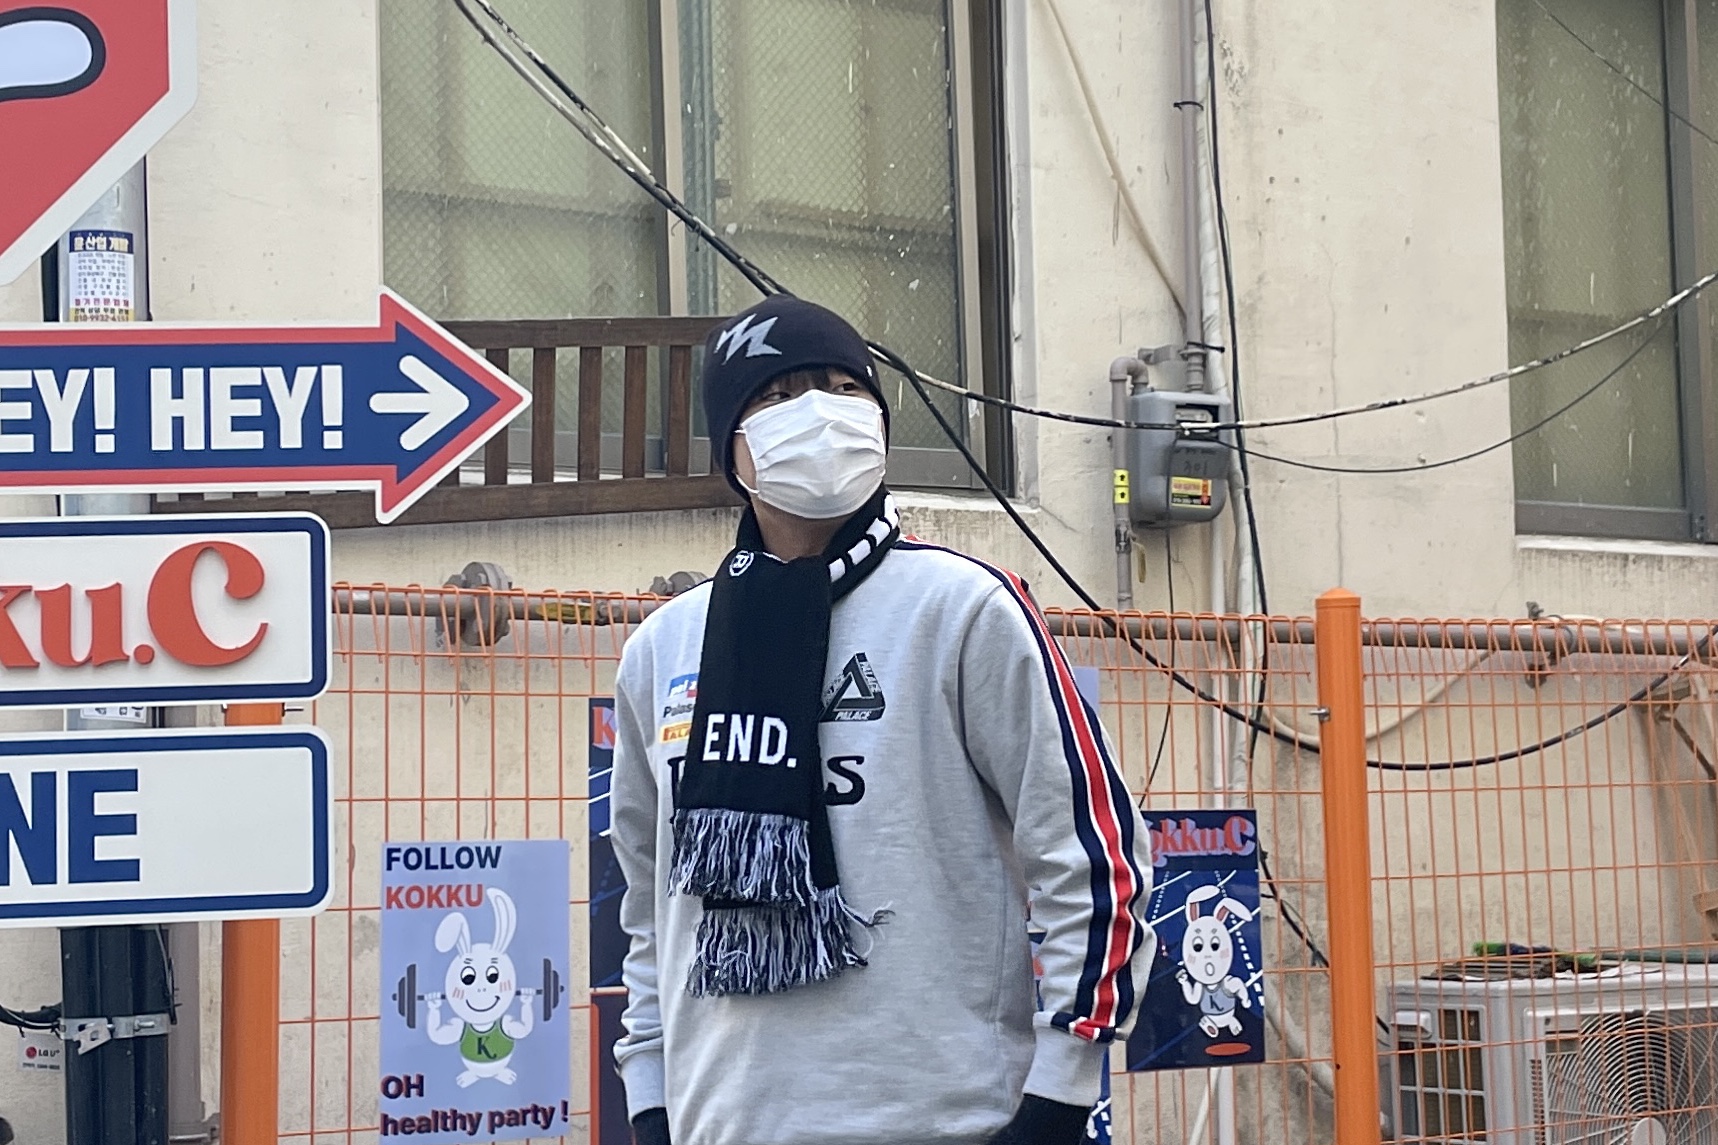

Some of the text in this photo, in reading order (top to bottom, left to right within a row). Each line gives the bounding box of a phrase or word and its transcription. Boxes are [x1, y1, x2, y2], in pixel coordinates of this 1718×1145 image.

[150, 364, 343, 451] HEY!
[702, 713, 798, 769] END.
[386, 846, 502, 871] FOLLOW
[386, 883, 484, 909] KOKKU
[380, 1073, 425, 1099] OH
[380, 1107, 483, 1137] healthy
[487, 1102, 556, 1135] party
